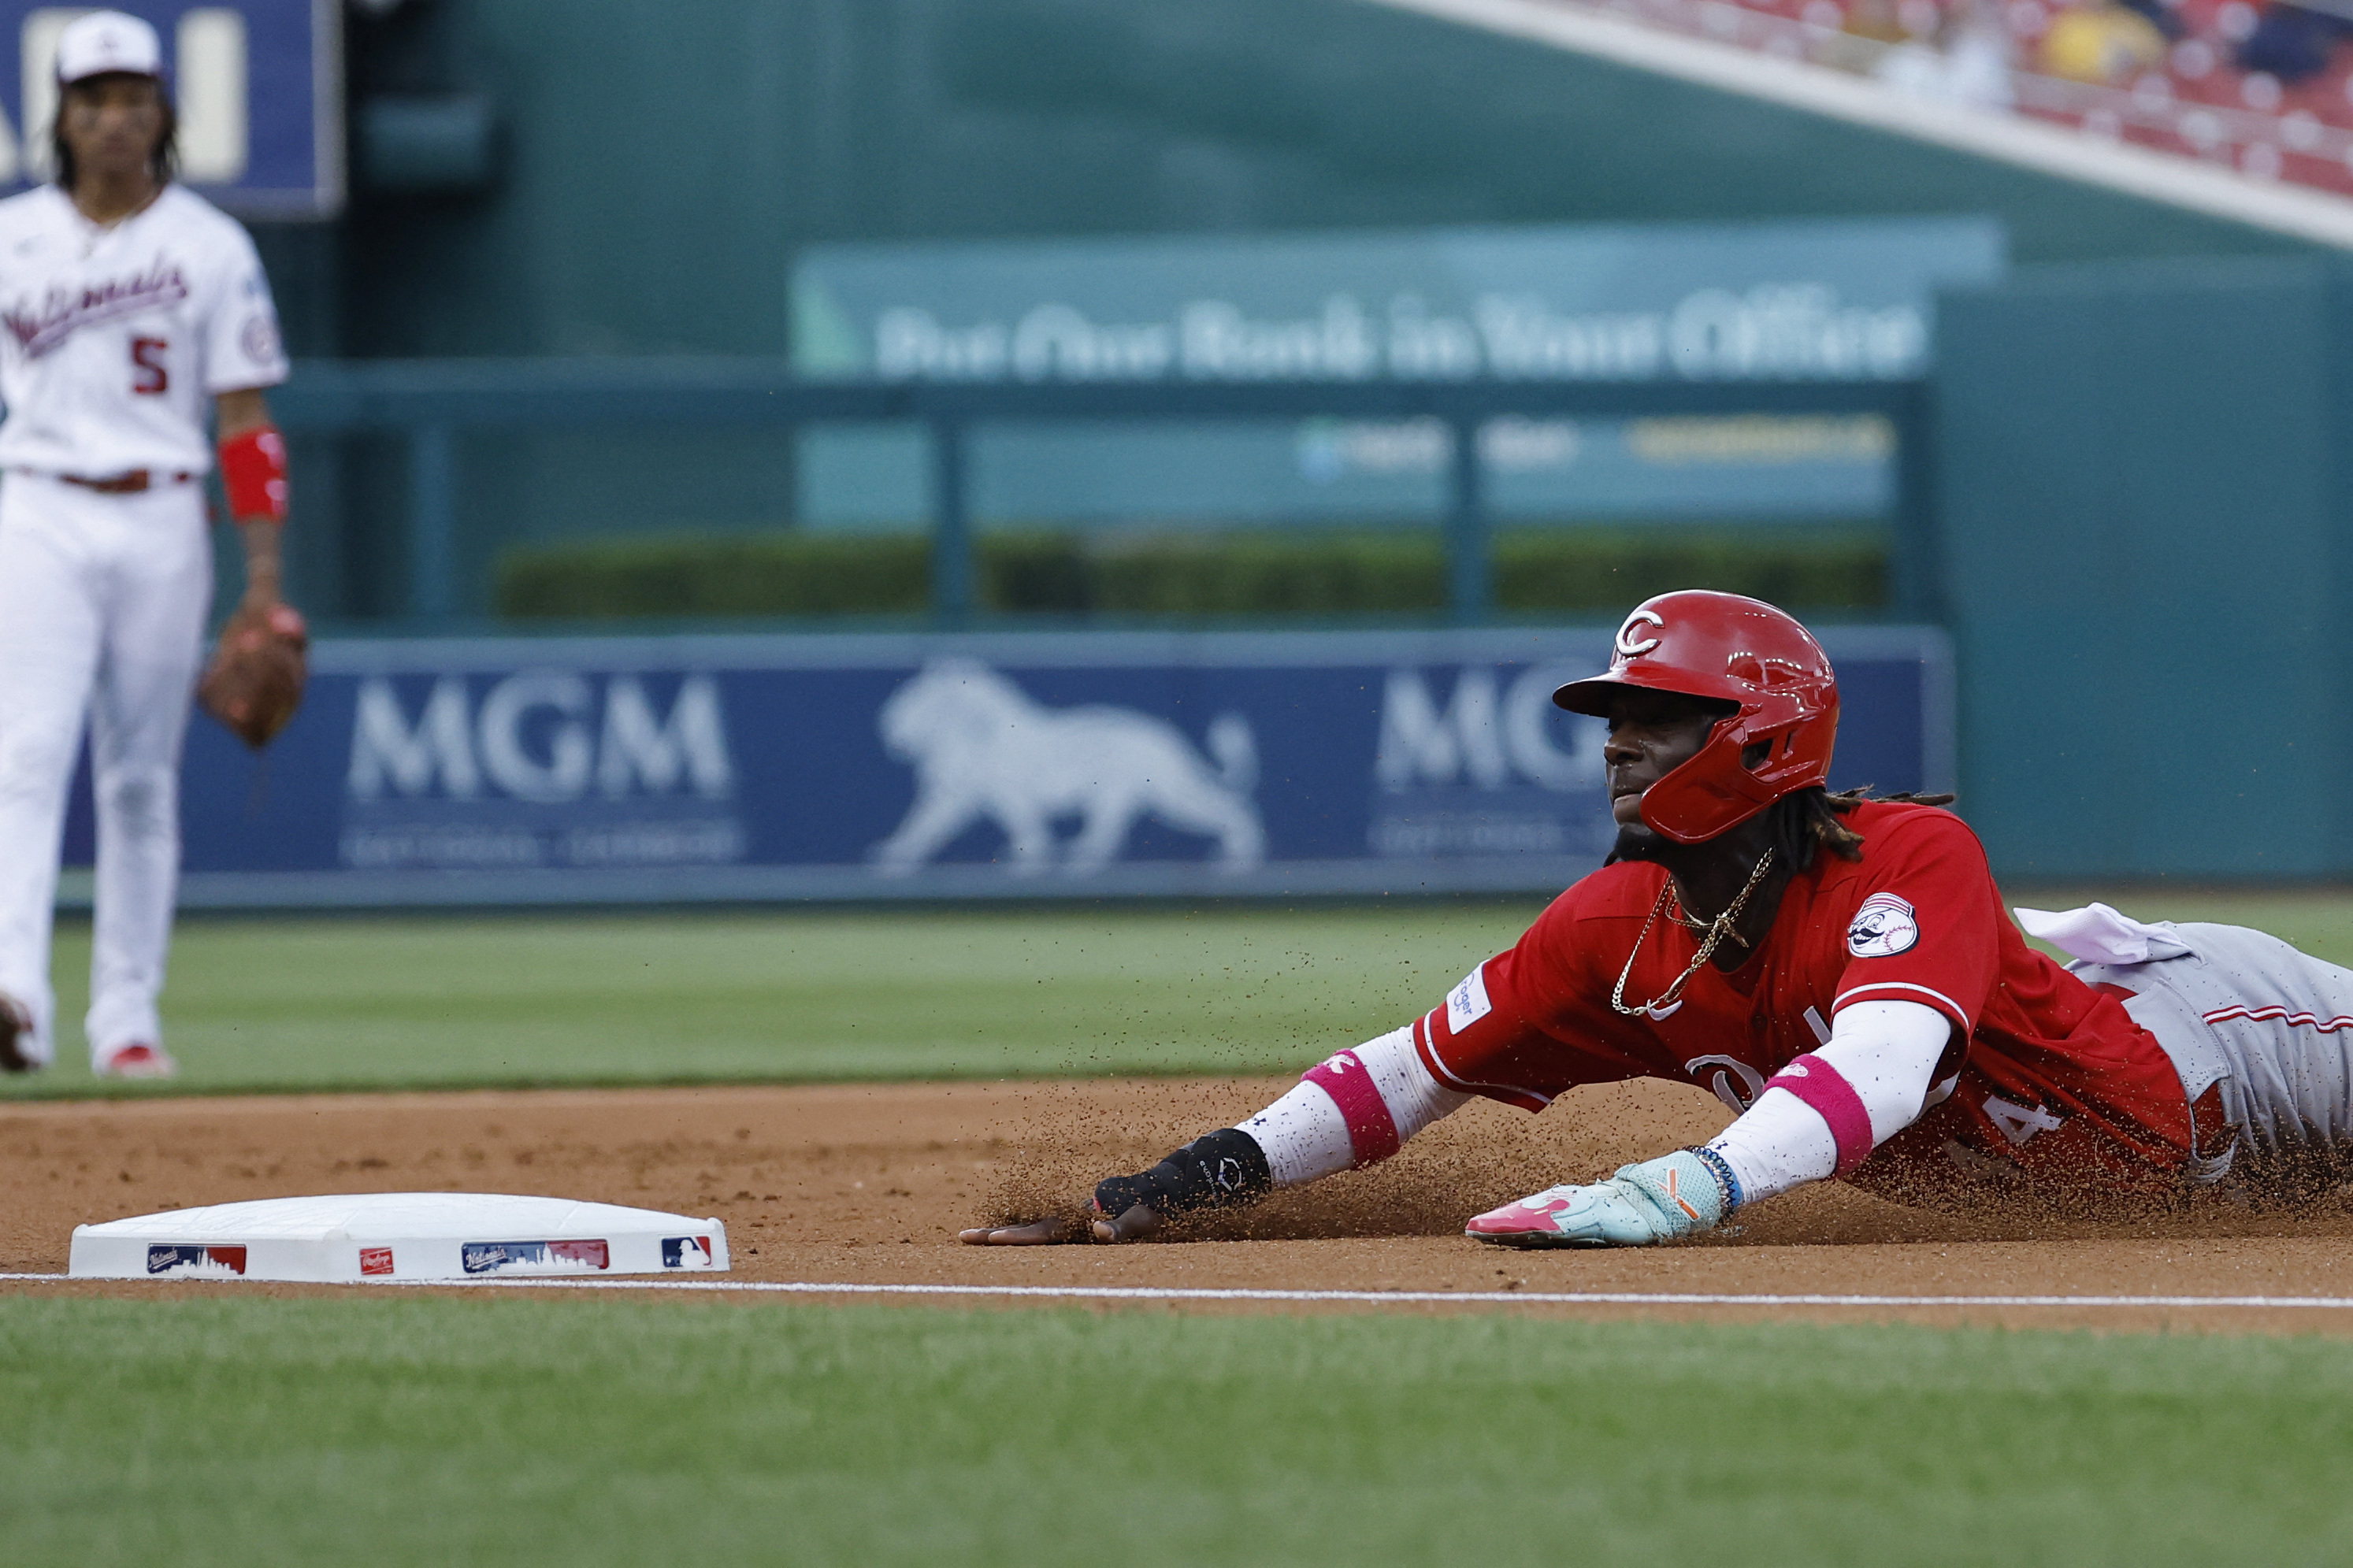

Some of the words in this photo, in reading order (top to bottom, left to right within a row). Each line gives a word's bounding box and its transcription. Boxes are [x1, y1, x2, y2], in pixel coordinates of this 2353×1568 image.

[132, 335, 169, 395] 5
[876, 307, 1007, 380] Put
[1016, 304, 1169, 380] Our
[1183, 301, 1377, 380] Bank
[1390, 293, 1479, 380] in
[1481, 291, 1657, 380] Your
[1668, 285, 1927, 380] Office
[1615, 610, 1665, 657] C
[349, 666, 731, 802] MGM
[1377, 658, 1612, 791] MG
